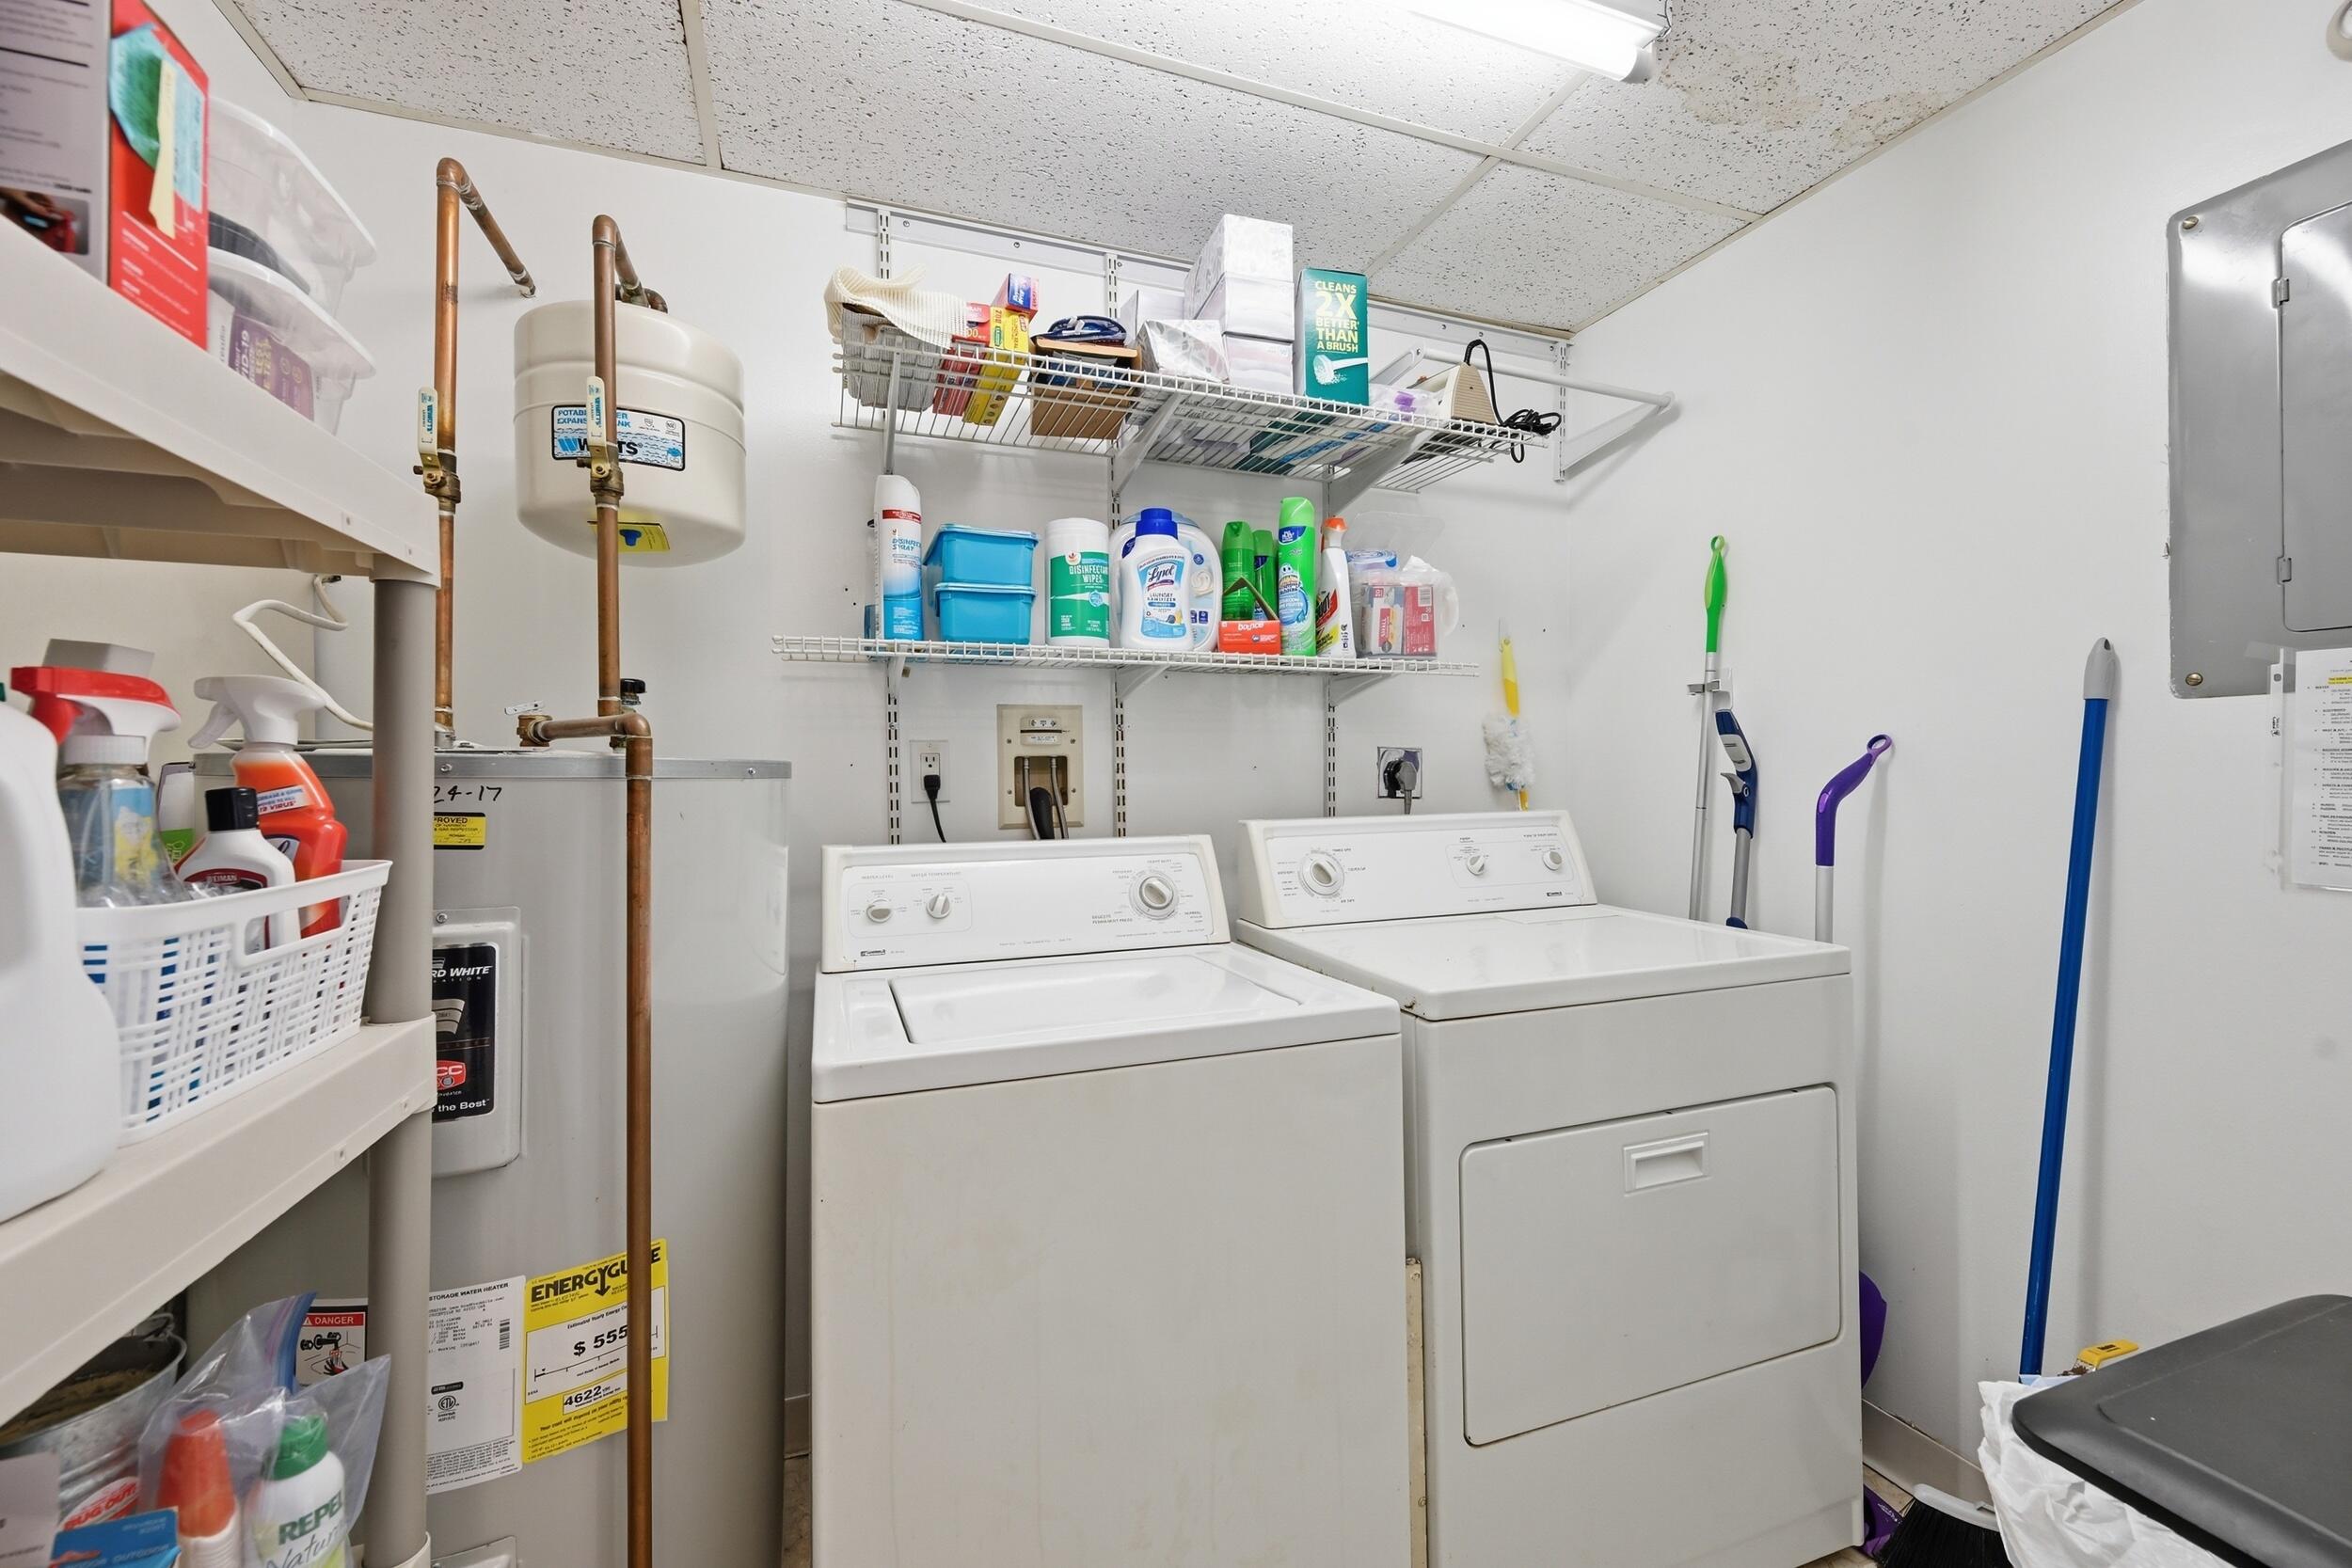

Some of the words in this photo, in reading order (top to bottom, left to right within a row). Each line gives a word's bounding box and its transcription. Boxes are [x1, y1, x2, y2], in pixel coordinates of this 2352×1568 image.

[1315, 281, 1357, 293] CLEANS
[1317, 291, 1357, 320] 2X
[1317, 327, 1358, 343] THAN
[1317, 341, 1325, 350] A
[1327, 341, 1358, 353] BRUSH
[1149, 565, 1175, 581] Lysol
[1237, 621, 1264, 631] bounce
[450, 966, 493, 977] WHITE
[437, 1103, 456, 1113] the
[483, 1282, 509, 1292] HEATER
[314, 1316, 354, 1324] DANGER
[567, 1319, 591, 1329] Estimated
[605, 1307, 621, 1316] Energy
[573, 1341, 586, 1356] $
[564, 1386, 602, 1406] 4622
